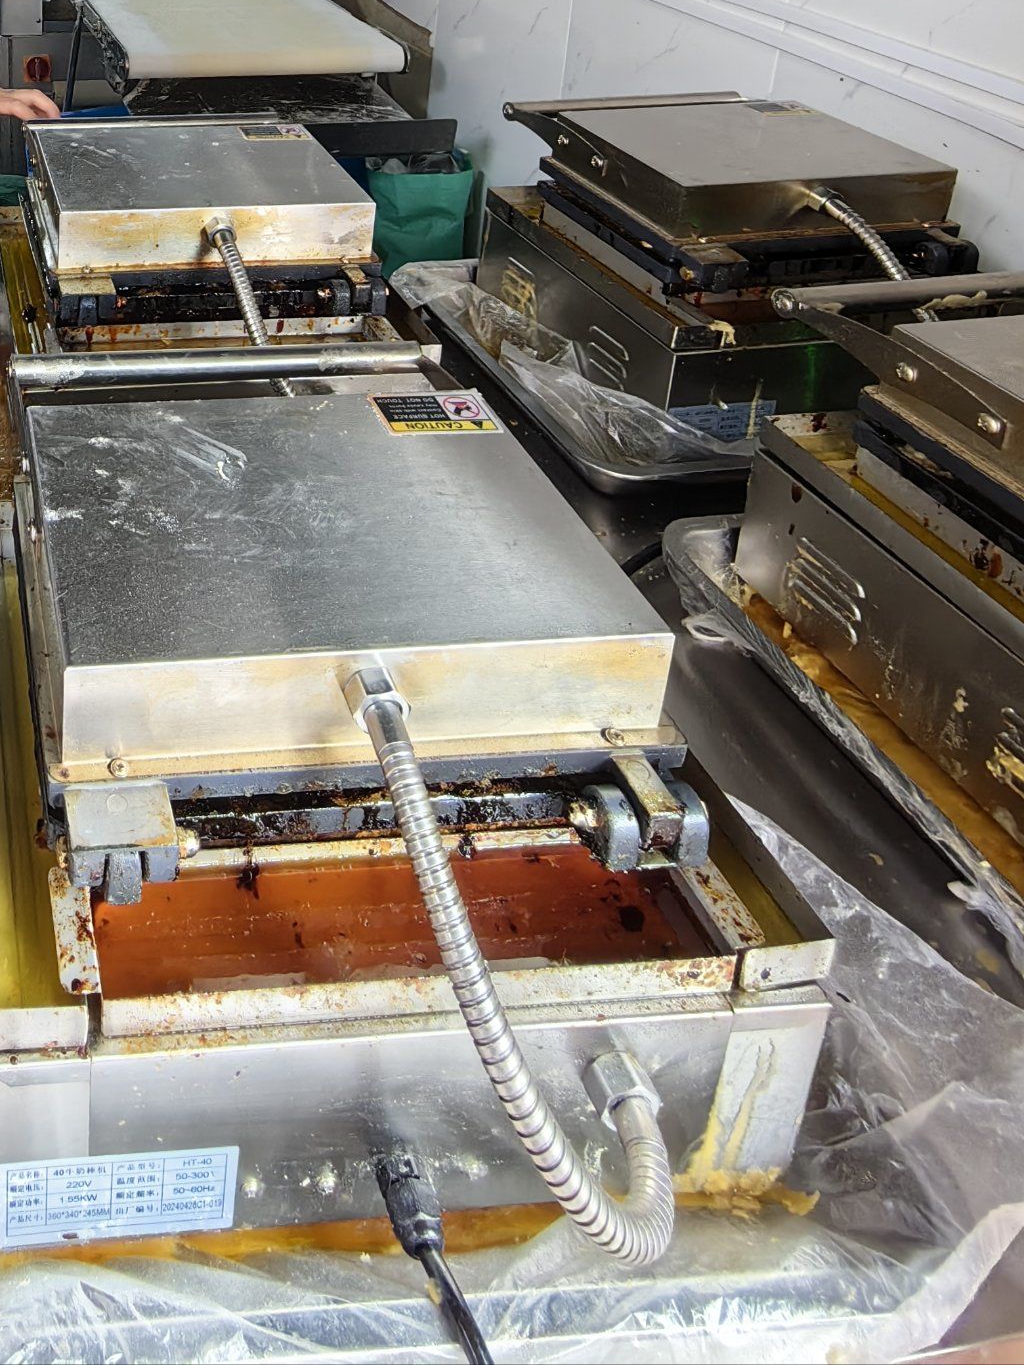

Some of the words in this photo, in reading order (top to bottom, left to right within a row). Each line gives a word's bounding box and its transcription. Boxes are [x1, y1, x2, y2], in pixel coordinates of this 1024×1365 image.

[405, 422, 463, 430] CAUTION
[183, 1157, 212, 1167] HT-40
[66, 1180, 92, 1189] 220V
